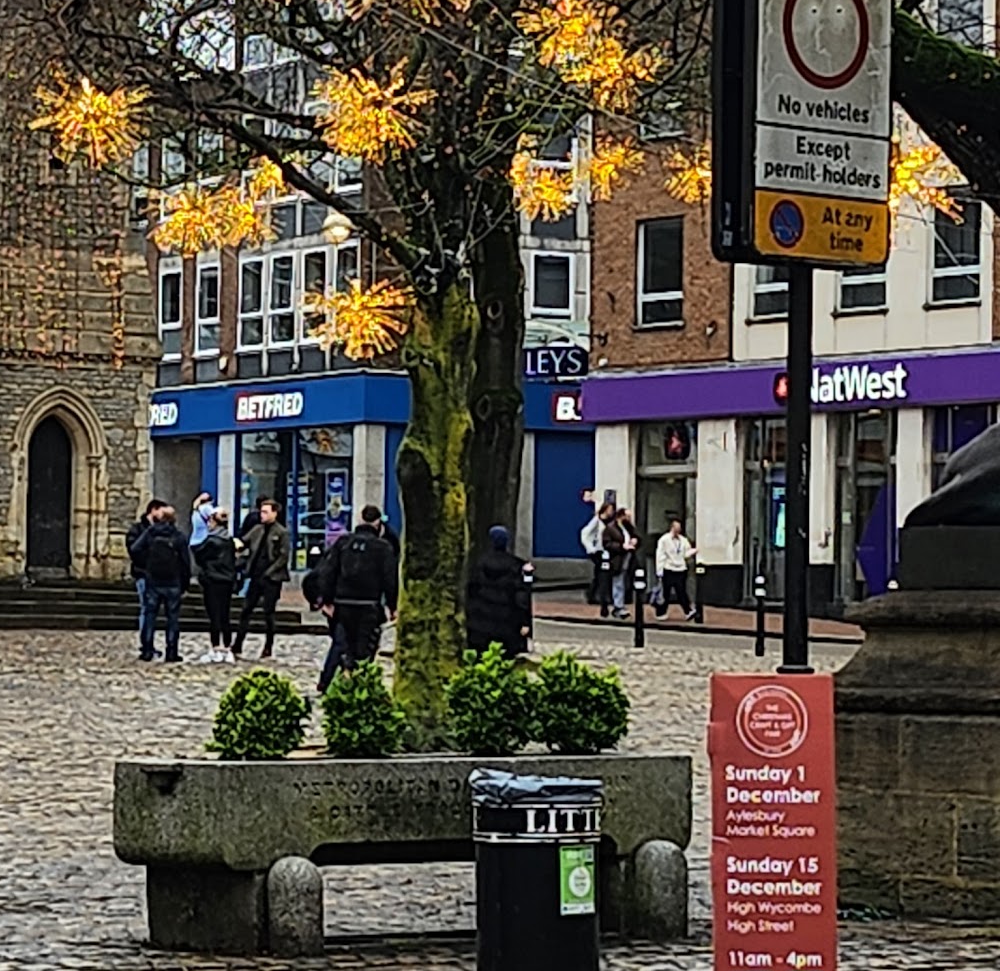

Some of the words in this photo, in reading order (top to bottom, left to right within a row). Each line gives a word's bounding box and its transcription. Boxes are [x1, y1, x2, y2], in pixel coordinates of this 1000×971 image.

[778, 94, 801, 116] No
[806, 100, 870, 124] vehicles
[796, 136, 851, 161] Except
[821, 207, 841, 226] At
[845, 215, 874, 233] any
[830, 231, 864, 252] time
[525, 349, 583, 375] LEYS
[236, 392, 304, 421] BETFRED
[725, 764, 793, 785] Sunday
[797, 765, 805, 783] 1
[727, 786, 822, 803] December
[725, 809, 786, 823] Aylesbury
[726, 824, 770, 837] Market
[772, 824, 816, 838] Square
[726, 856, 794, 877] Sunday
[799, 857, 820, 874] 15
[727, 878, 823, 896] December
[727, 901, 757, 916] High
[757, 901, 822, 915] Wycombe
[727, 919, 757, 934] High
[758, 919, 795, 933] Street
[729, 950, 773, 967] 11am
[786, 950, 823, 969] 4pm
